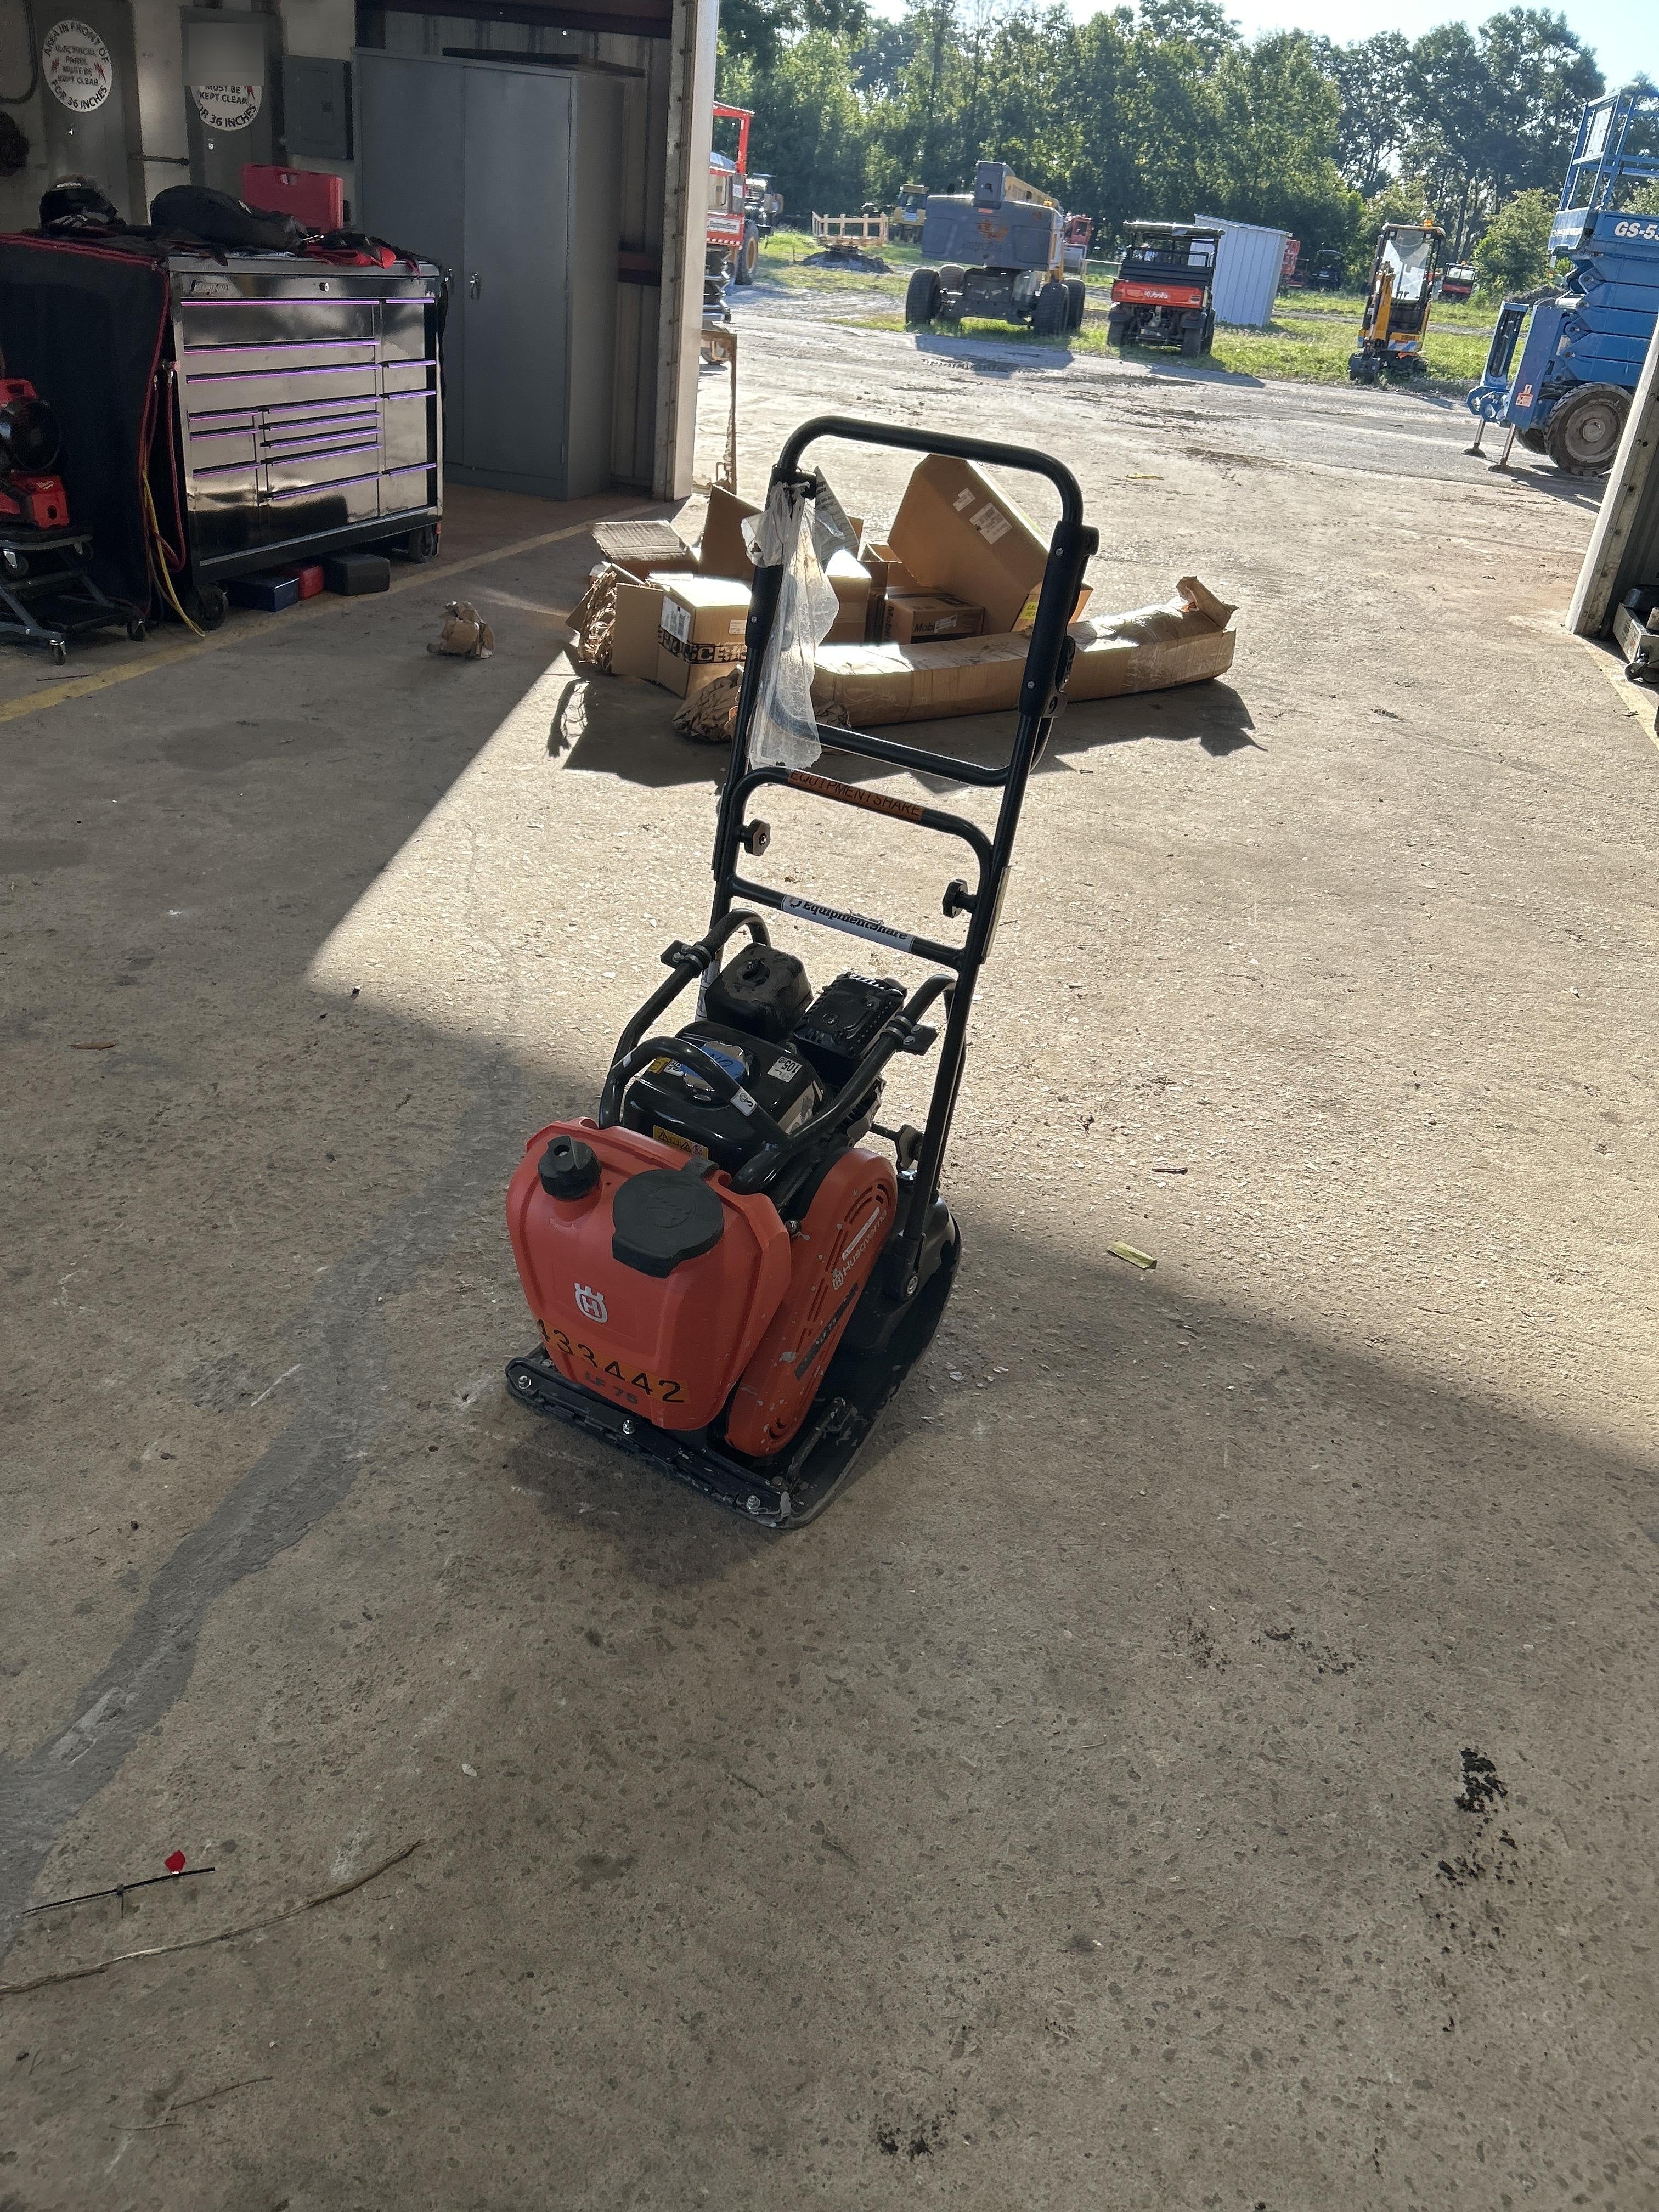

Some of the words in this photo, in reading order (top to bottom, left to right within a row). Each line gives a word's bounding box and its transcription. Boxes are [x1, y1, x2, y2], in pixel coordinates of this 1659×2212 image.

[99, 48, 109, 63] OF
[76, 78, 99, 86] CLEAR
[67, 96, 78, 108] 36
[81, 85, 108, 109] INCHES
[199, 91, 219, 101] KEPT
[221, 94, 247, 105] CLEAR
[210, 114, 222, 126] 36
[224, 104, 256, 127] INCHES
[790, 771, 920, 816] EQUIPMENTSHARE
[802, 901, 907, 940] EquipmentShare
[781, 1060, 800, 1074] 105
[842, 1209, 887, 1276] Husqvarna
[585, 1371, 606, 1387] LF
